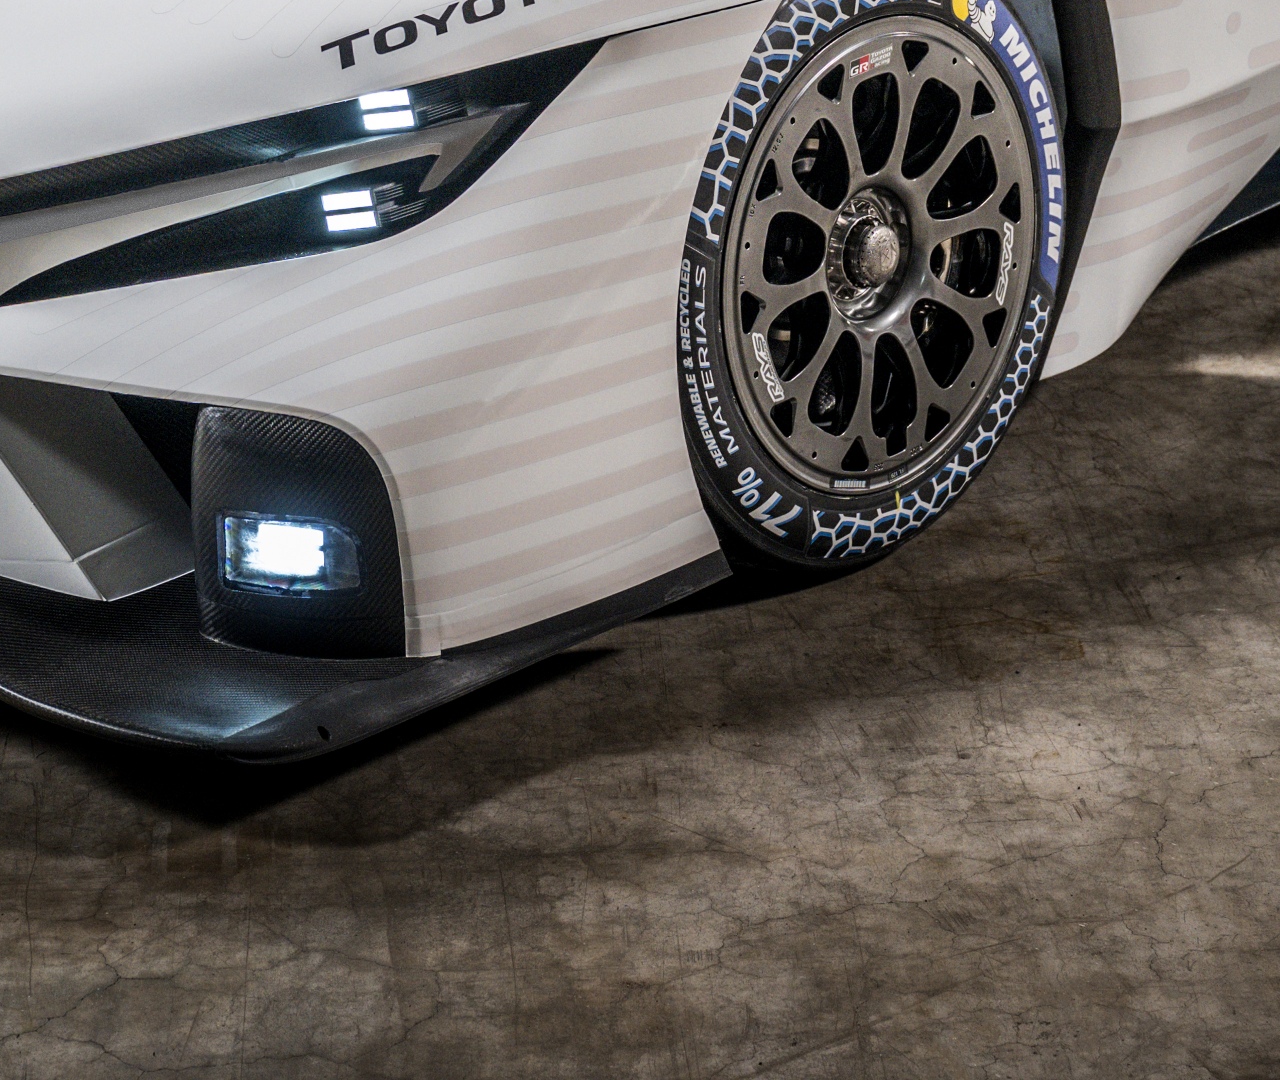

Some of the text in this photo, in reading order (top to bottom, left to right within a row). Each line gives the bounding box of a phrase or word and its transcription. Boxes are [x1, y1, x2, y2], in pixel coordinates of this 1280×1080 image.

[871, 44, 893, 58] TOYOTA
[999, 24, 1062, 263] MICHELIN
[996, 222, 1014, 306] RAYS
[680, 258, 728, 469] RENEWABLE & RECYCLED
[695, 265, 803, 538] 71% MATERIALS
[752, 332, 785, 402] RAYS
